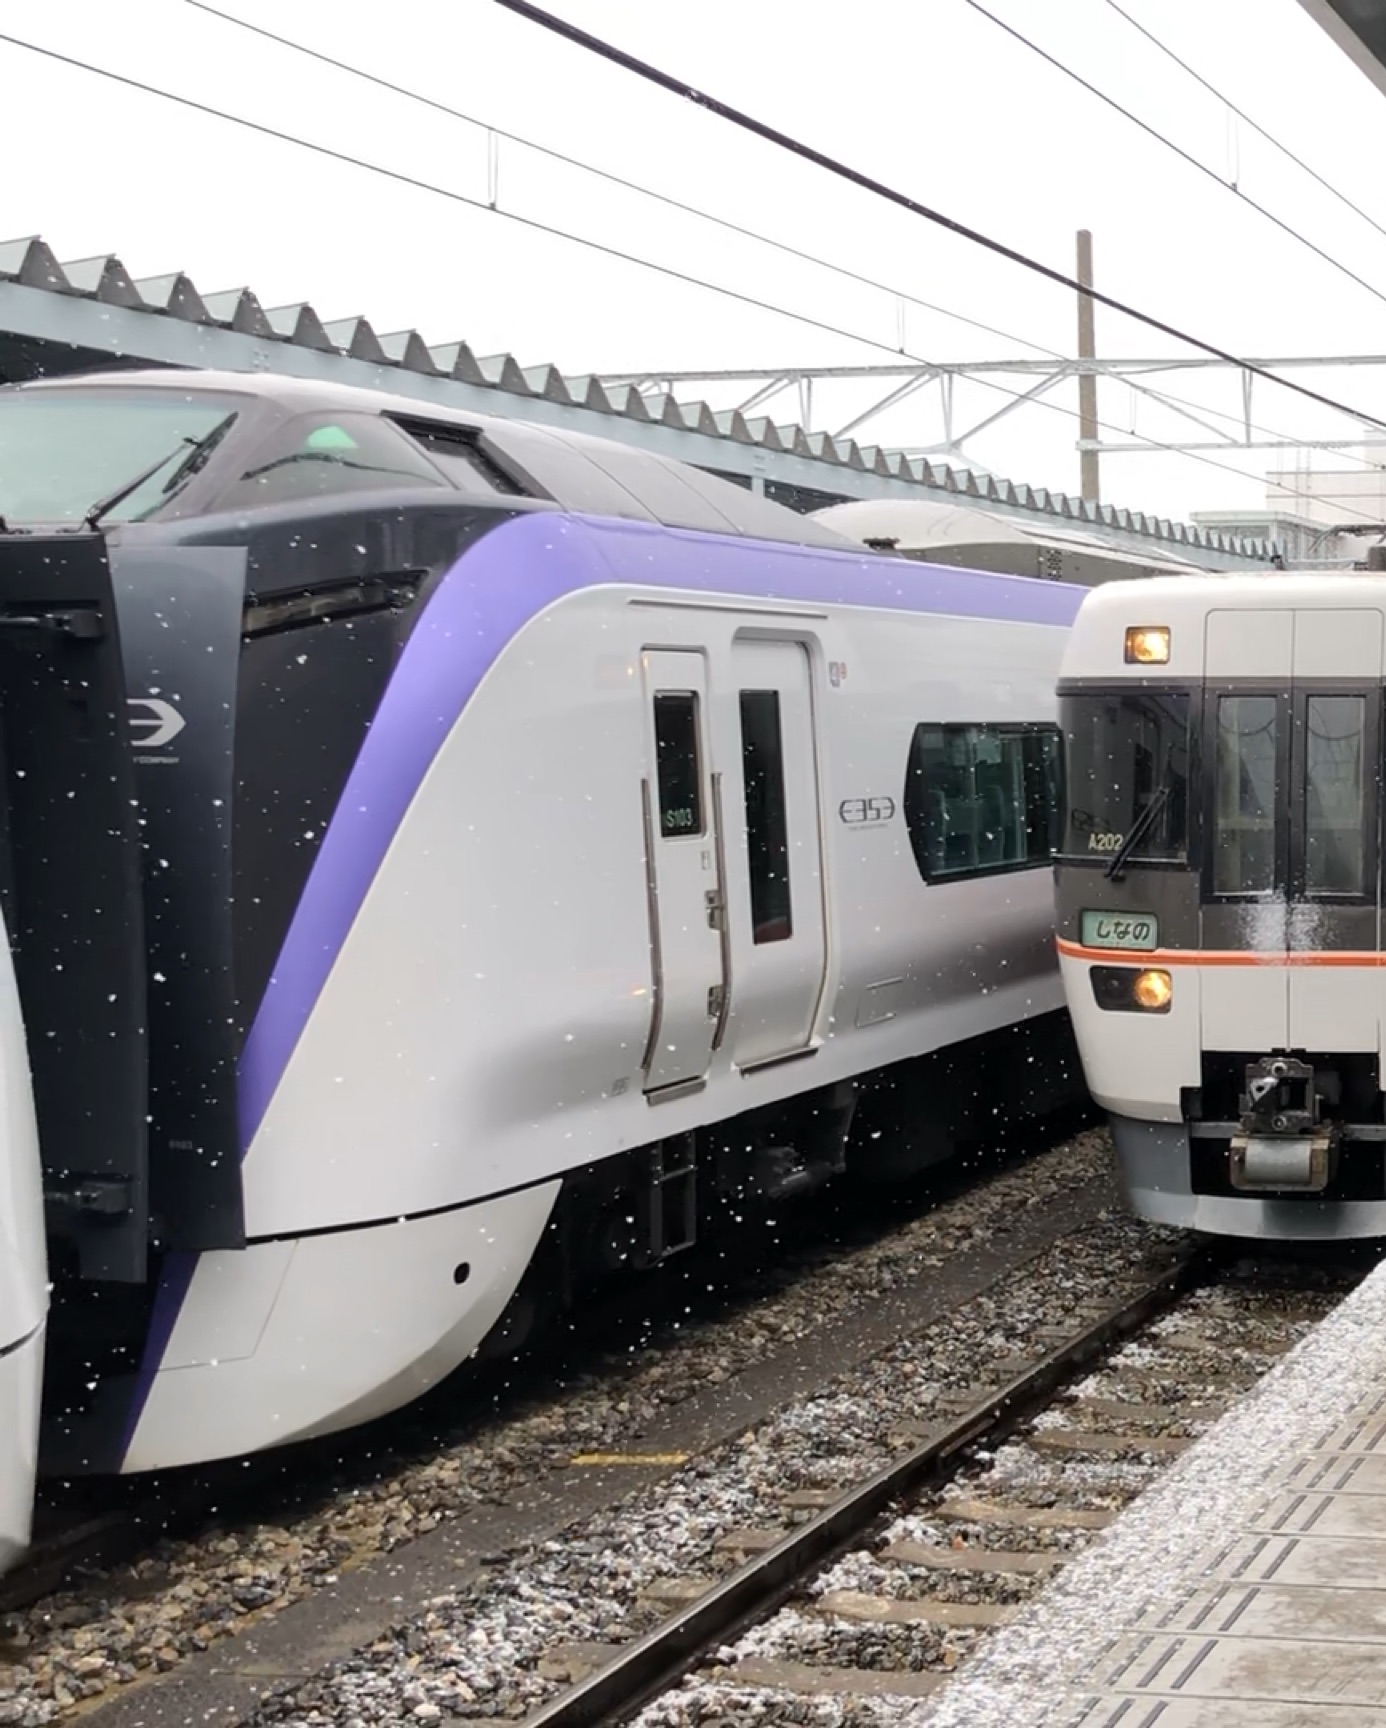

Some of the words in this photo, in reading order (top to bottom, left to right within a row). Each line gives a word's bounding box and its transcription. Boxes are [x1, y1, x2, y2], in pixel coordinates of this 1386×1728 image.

[1087, 833, 1124, 851] A202
[1096, 920, 1151, 941] しなの
